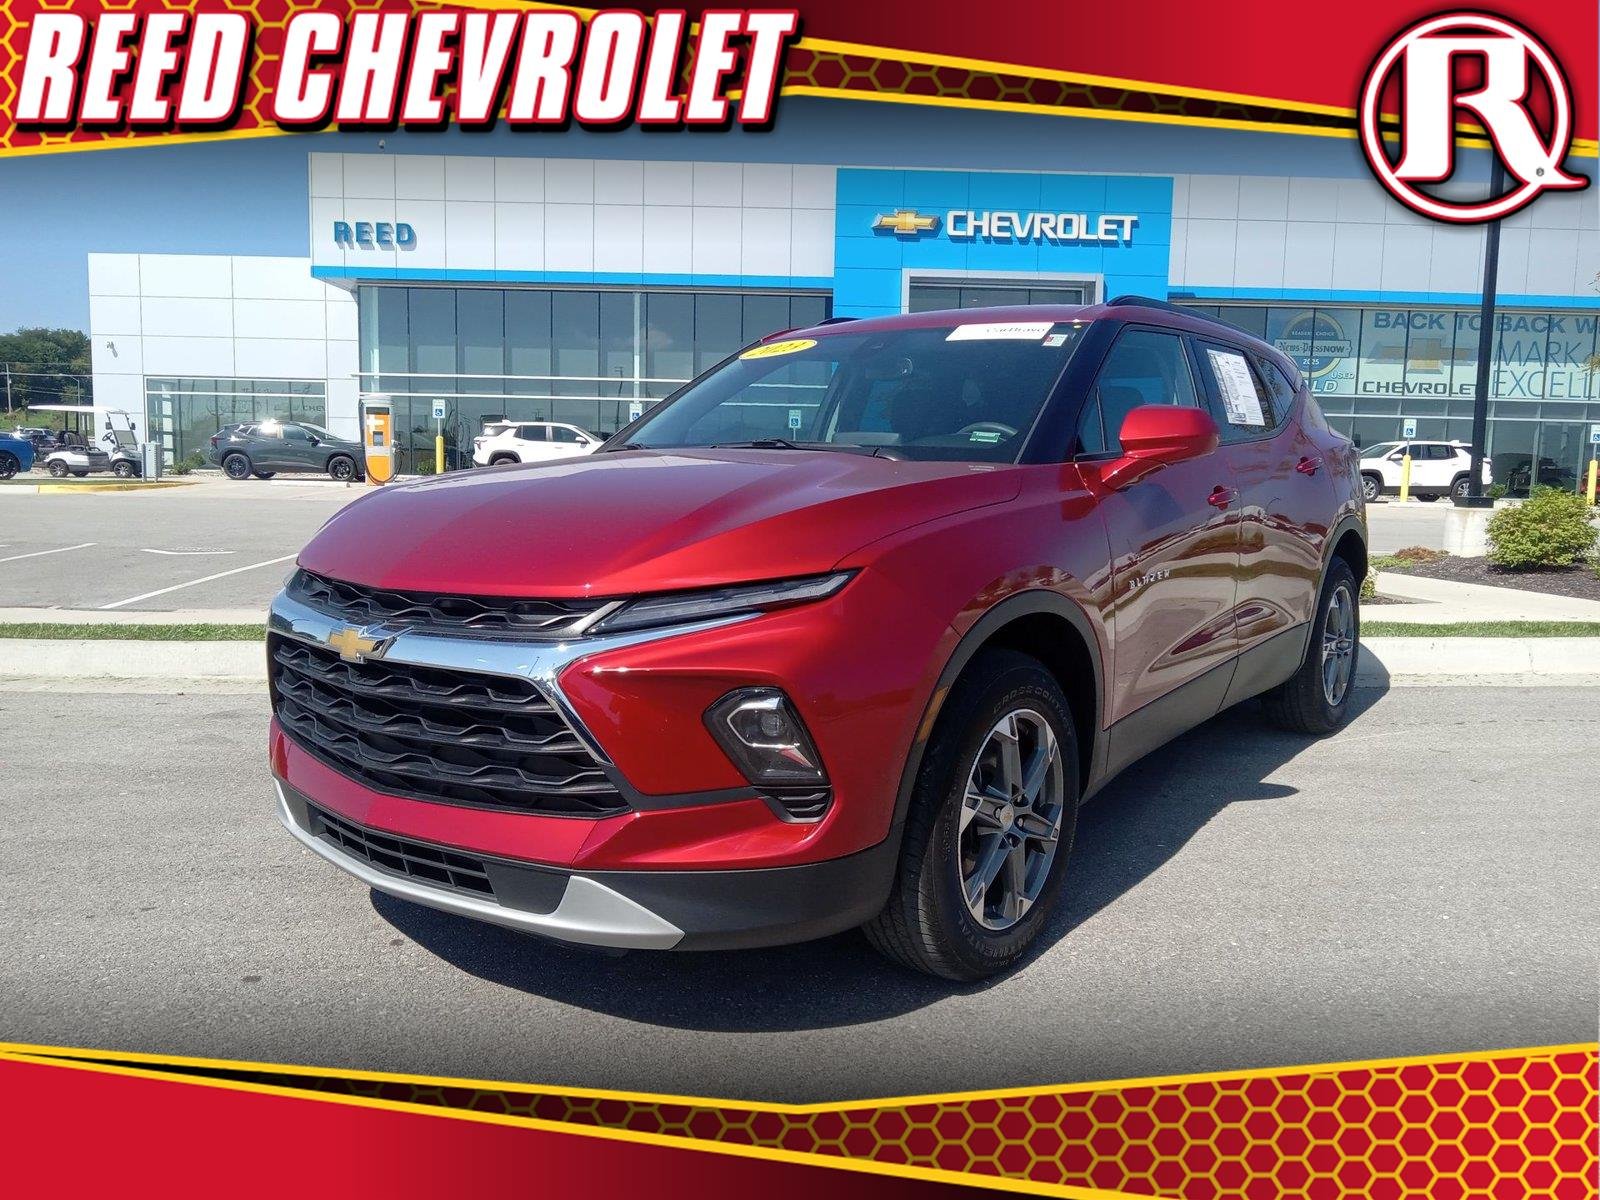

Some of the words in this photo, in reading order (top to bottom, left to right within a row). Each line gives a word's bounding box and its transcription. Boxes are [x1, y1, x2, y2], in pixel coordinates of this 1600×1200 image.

[333, 221, 417, 248] REED
[946, 210, 1139, 242] CHEVROLET
[1374, 312, 1445, 330] BACK
[1495, 315, 1567, 334] BACK
[1493, 340, 1581, 368] MARK
[1362, 381, 1478, 396] CHEVROLE
[1491, 370, 1600, 399] EXCELL
[1128, 569, 1170, 590] BLAZER
